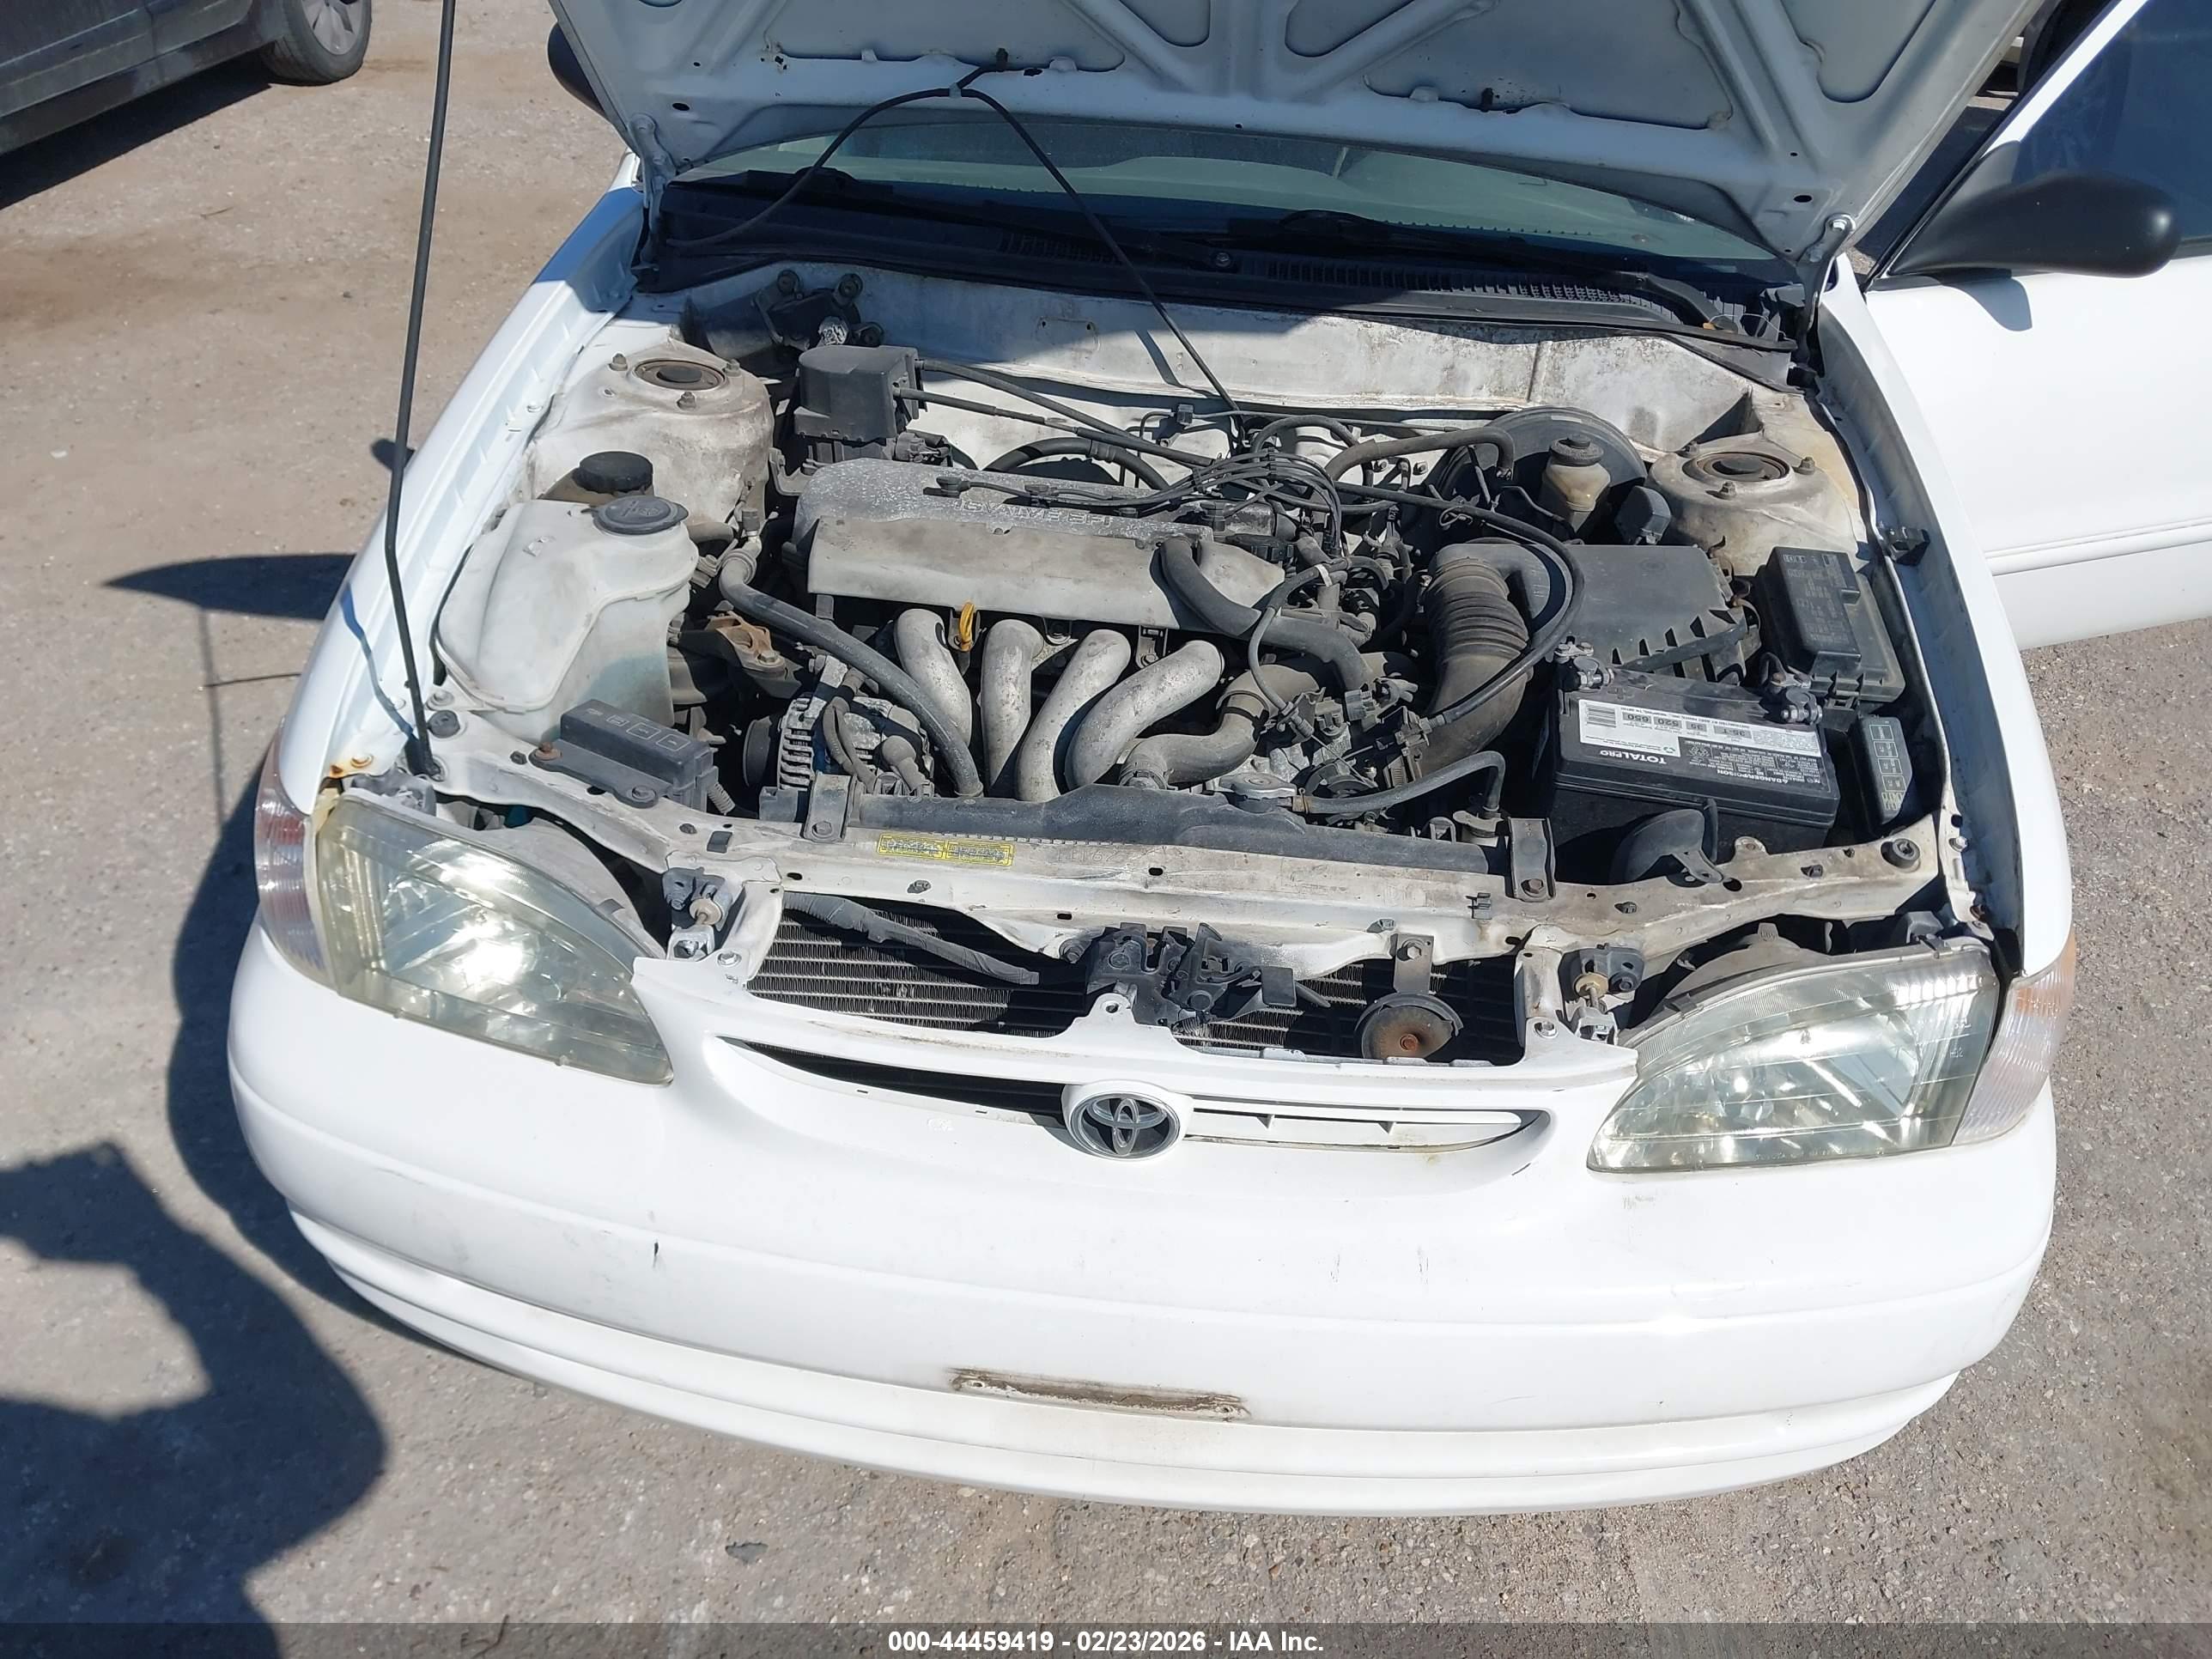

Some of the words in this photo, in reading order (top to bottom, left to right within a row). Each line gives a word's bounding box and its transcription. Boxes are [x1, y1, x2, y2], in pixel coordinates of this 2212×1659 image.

[1067, 513, 1114, 526] EFI
[1627, 714, 1650, 722] 650
[1657, 718, 1680, 726] 520
[1600, 750, 1668, 764] TOTALPRO
